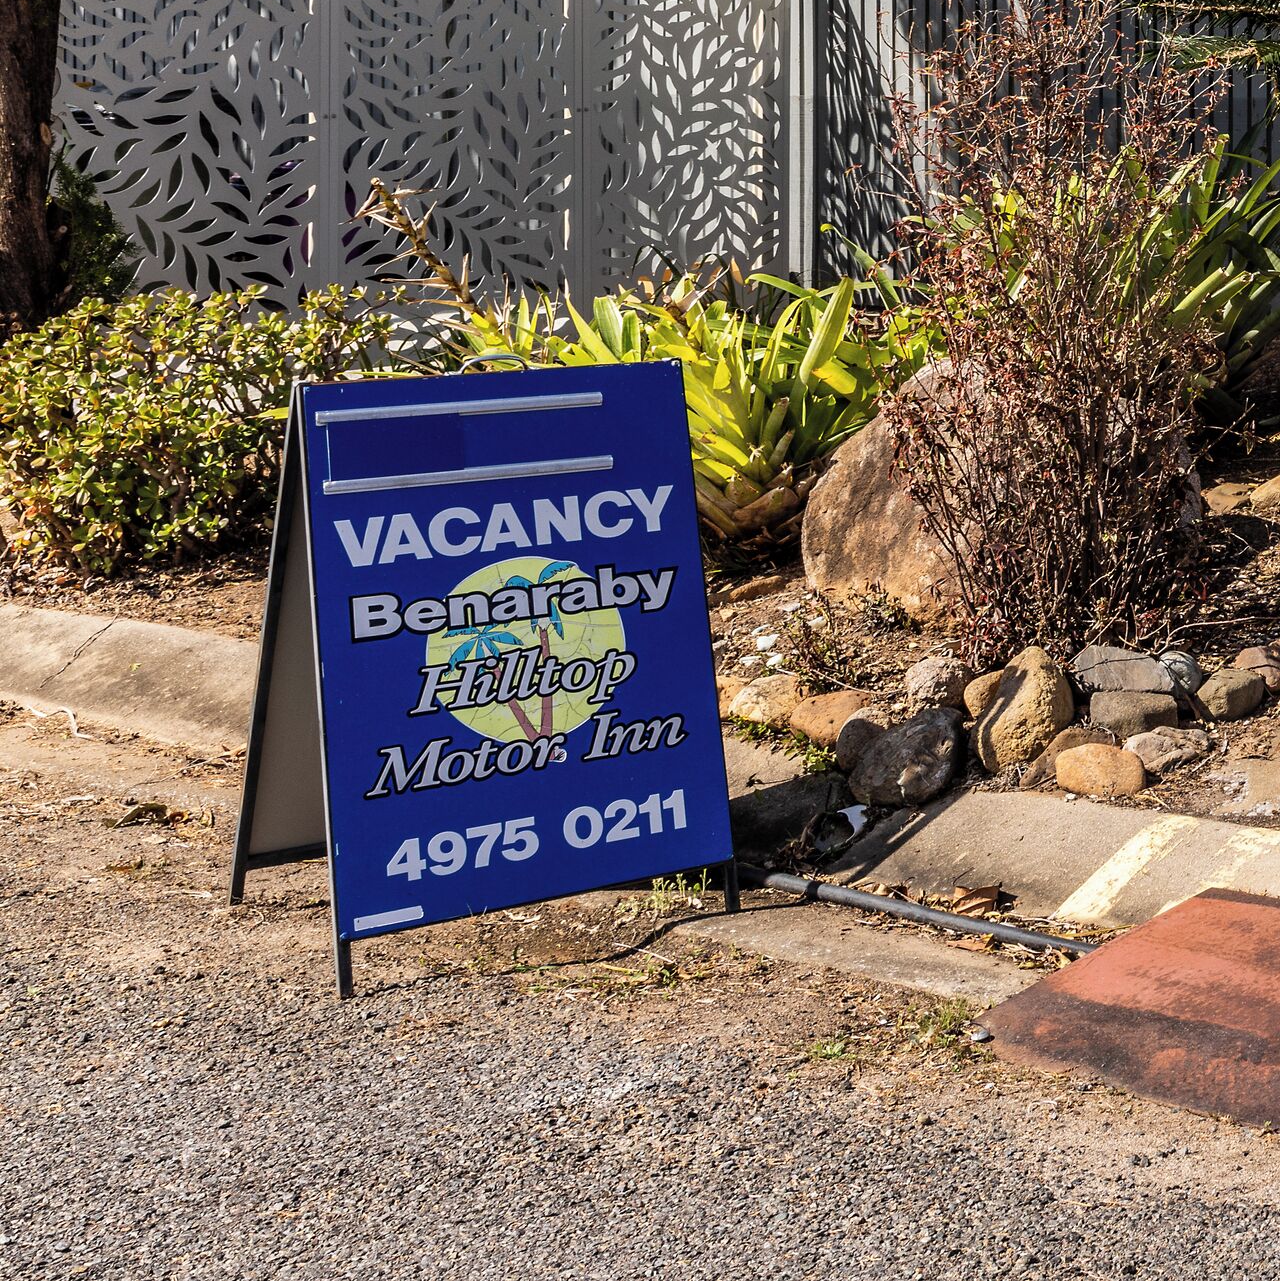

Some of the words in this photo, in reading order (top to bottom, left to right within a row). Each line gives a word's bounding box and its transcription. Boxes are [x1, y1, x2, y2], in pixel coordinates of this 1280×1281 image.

[334, 485, 673, 567] VACANCY
[352, 567, 676, 640] Benaraby
[411, 647, 635, 714] Hilltop
[366, 734, 564, 798] Motor
[584, 713, 686, 760] Inn
[386, 816, 538, 881] 4975
[564, 789, 687, 849] 0211
